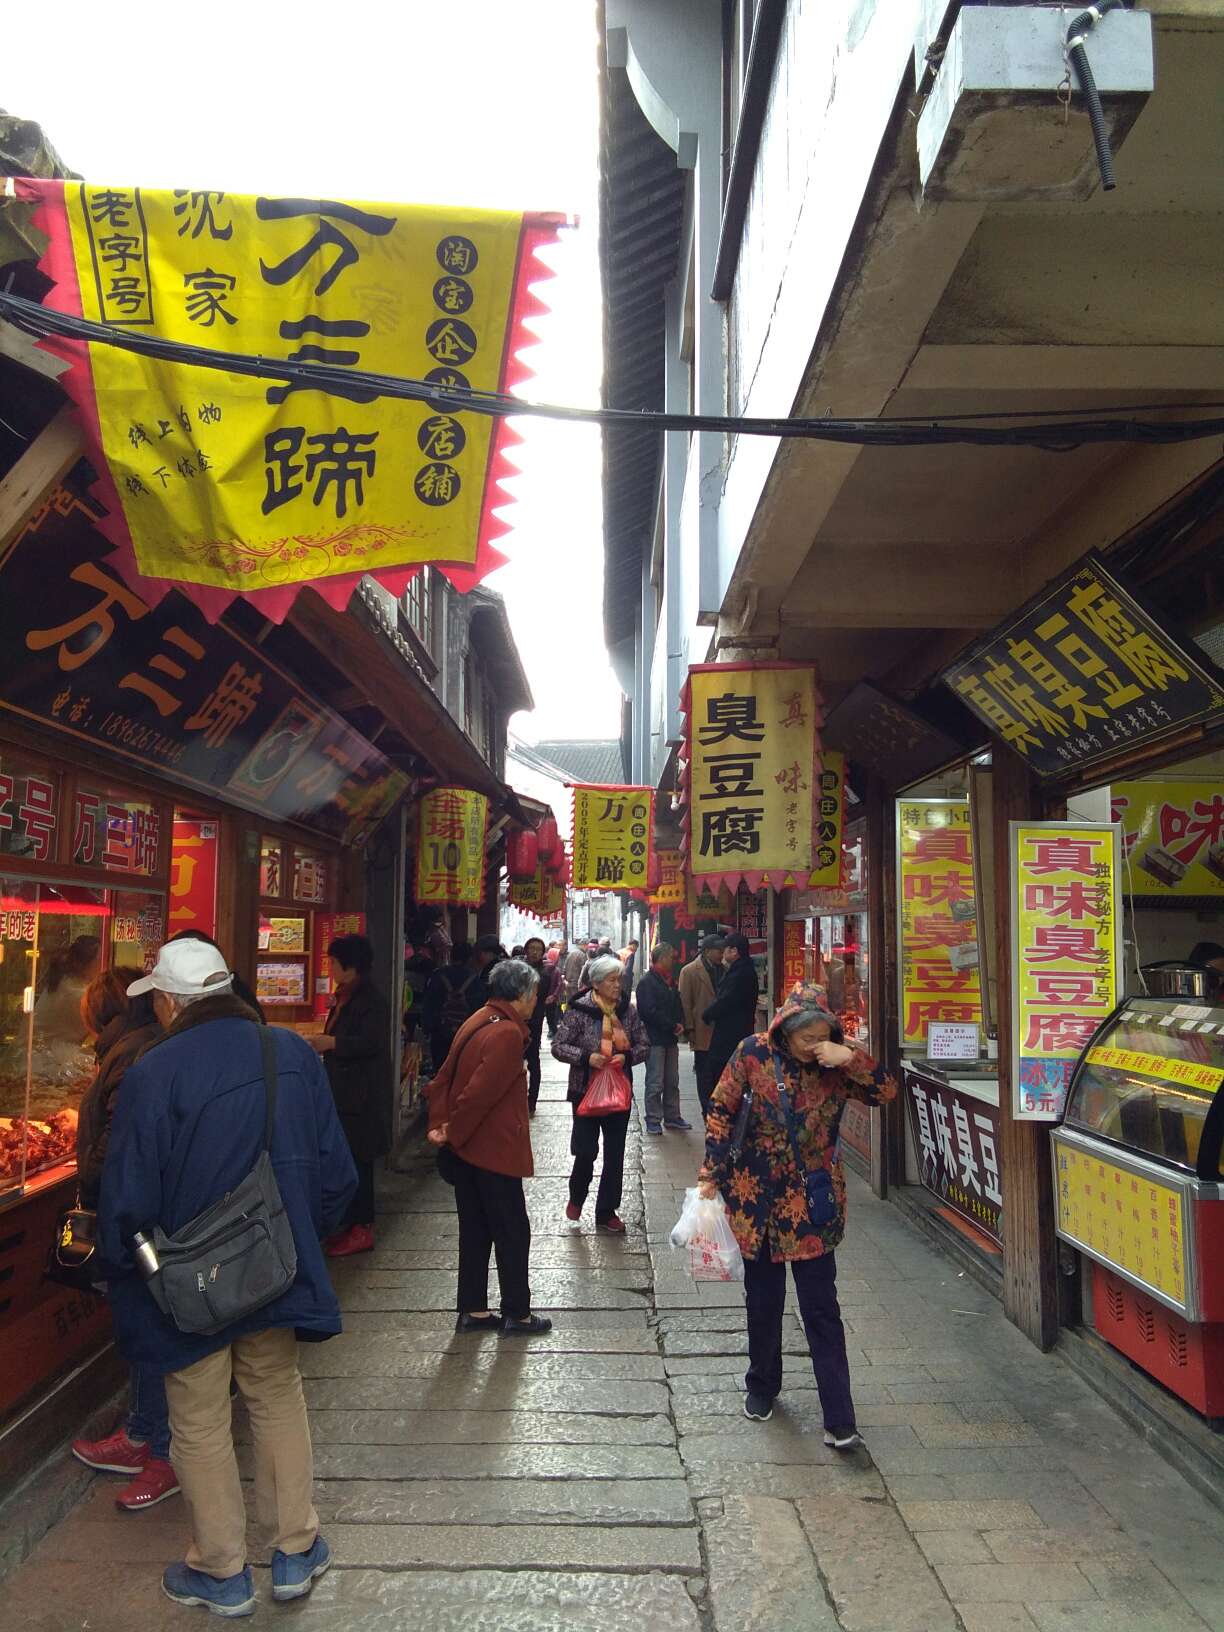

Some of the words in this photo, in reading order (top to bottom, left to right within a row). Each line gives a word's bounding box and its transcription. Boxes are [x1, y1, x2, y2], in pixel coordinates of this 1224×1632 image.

[90, 189, 146, 313] 老字号
[173, 189, 239, 326] 沈家
[255, 197, 397, 518] 万三蹄
[25, 561, 264, 749] 万三蹄
[956, 582, 1189, 755] 真味臭豆腐
[699, 693, 766, 857] 臭豆腐
[775, 692, 809, 794] 真味
[73, 792, 159, 876] 万三蹄
[425, 792, 468, 895] 全场10元
[596, 796, 628, 883] 万三蹄
[785, 801, 799, 851] 老字号
[902, 828, 981, 1038] 真味臭豆腐
[1022, 837, 1107, 1051] 真味臭豆腐
[1095, 862, 1111, 936] 独家秘方
[1095, 947, 1112, 1004] 老字号
[1025, 1093, 1056, 1111] 5元
